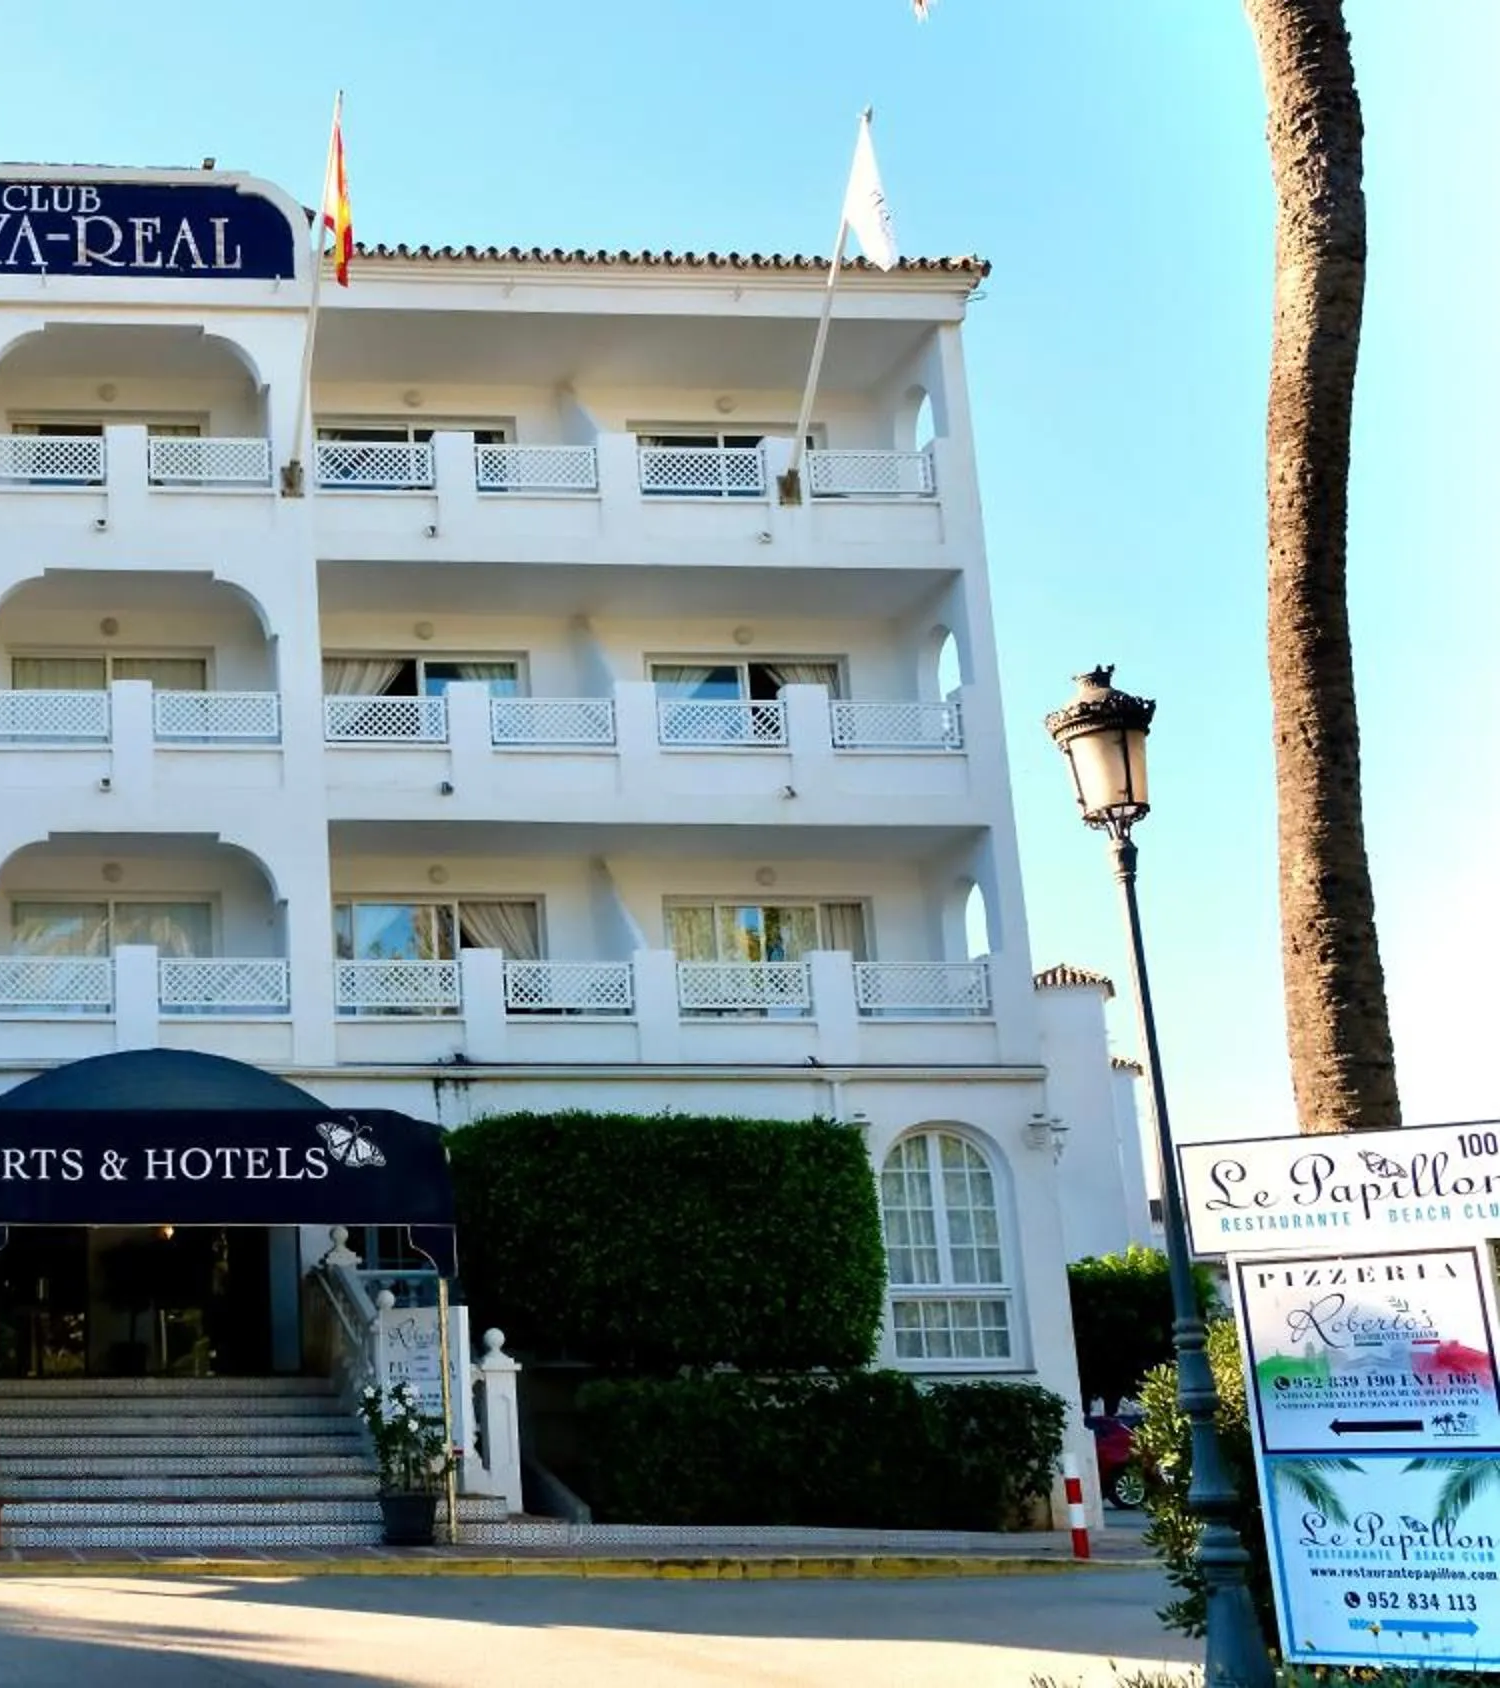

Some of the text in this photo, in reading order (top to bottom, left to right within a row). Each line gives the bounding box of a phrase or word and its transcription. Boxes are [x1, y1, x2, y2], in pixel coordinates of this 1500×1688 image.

[2, 185, 101, 213] CLUB
[1457, 1132, 1499, 1159] 100
[99, 1149, 129, 1181] &
[145, 1147, 329, 1180] HOTELS
[1205, 1159, 1281, 1211] Le
[1220, 1202, 1500, 1232] RESTAURANTE BEACH CLU
[1258, 1263, 1457, 1289] PIZZERIA
[1300, 1512, 1498, 1561] Le Papillon
[1367, 1591, 1477, 1611] 952 834 113
